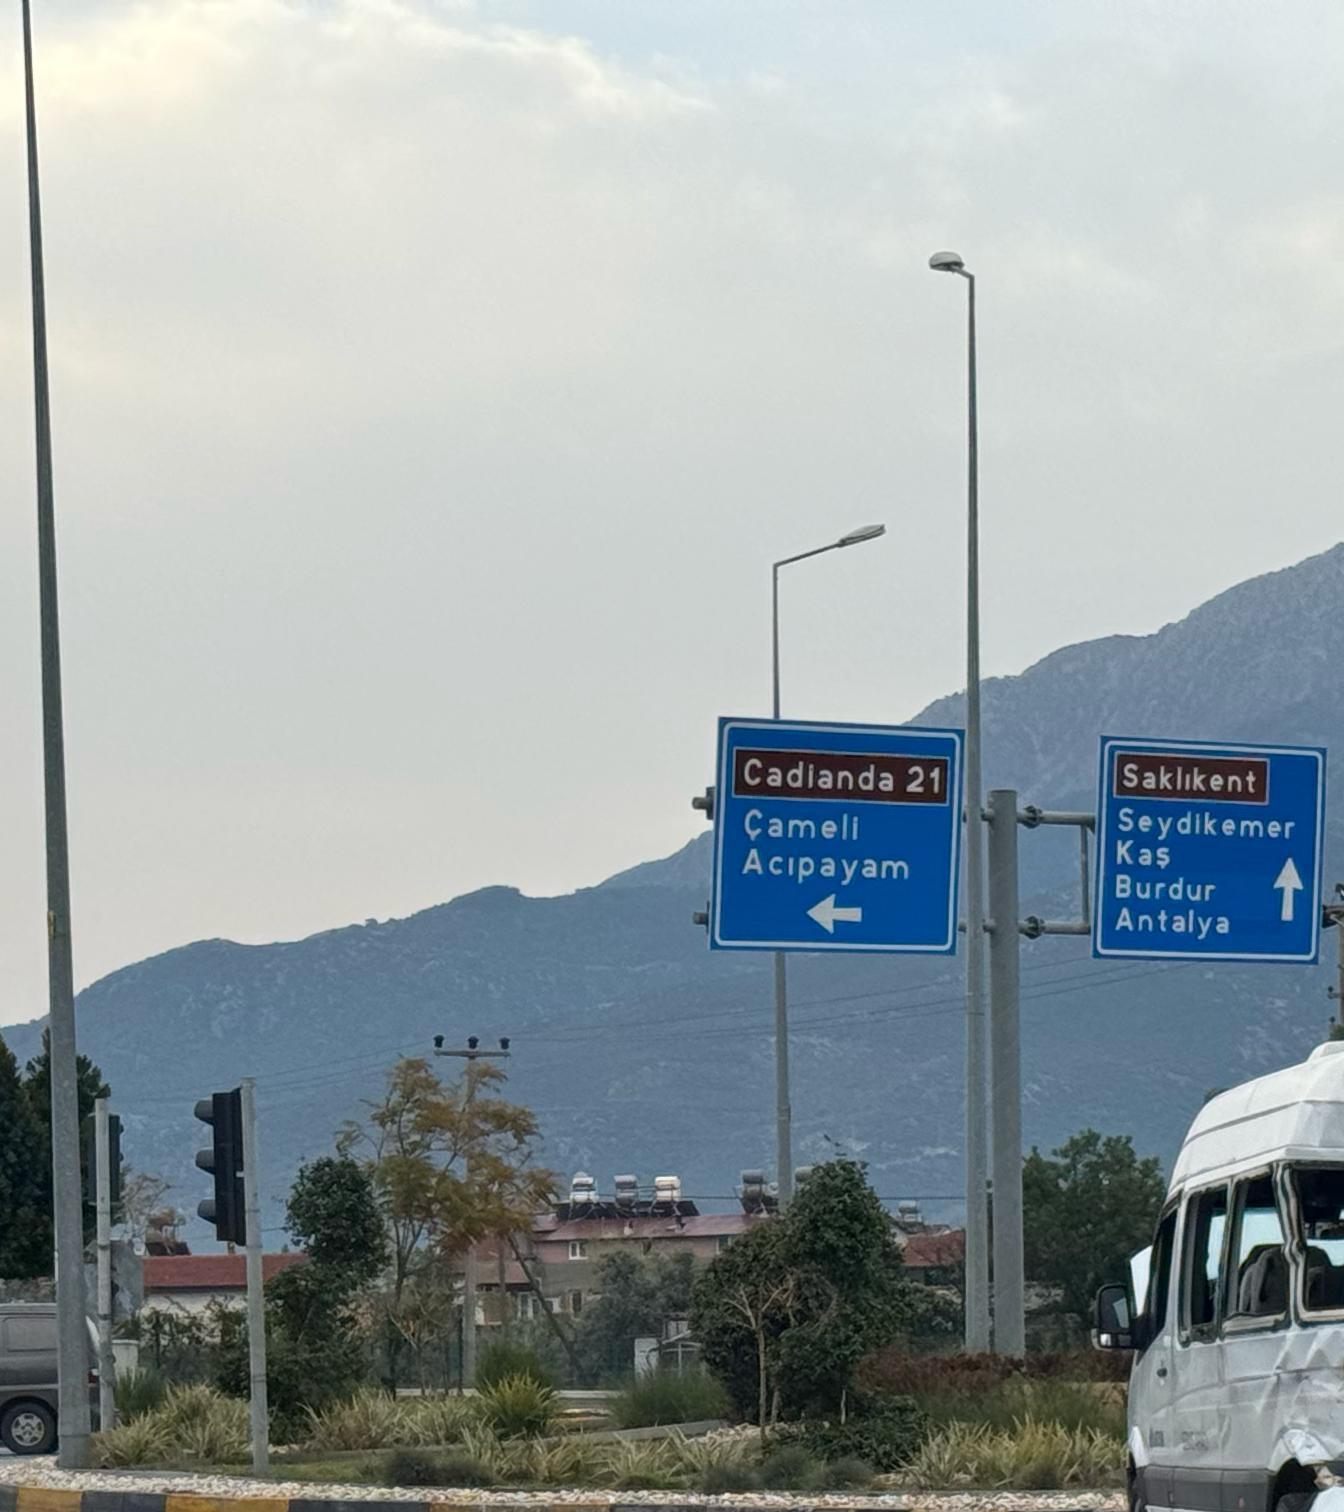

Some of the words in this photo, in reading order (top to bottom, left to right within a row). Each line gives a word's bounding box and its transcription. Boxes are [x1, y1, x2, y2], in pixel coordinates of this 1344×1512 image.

[906, 765, 940, 794] 21
[1122, 763, 1257, 794] Saklıkent
[744, 808, 859, 841] Çameli
[1118, 807, 1296, 840] Seydikemer
[742, 848, 910, 886] Acıpayam
[1116, 840, 1171, 869] Kaş
[1115, 874, 1216, 902] Burdur
[1115, 907, 1230, 940] Antalya
